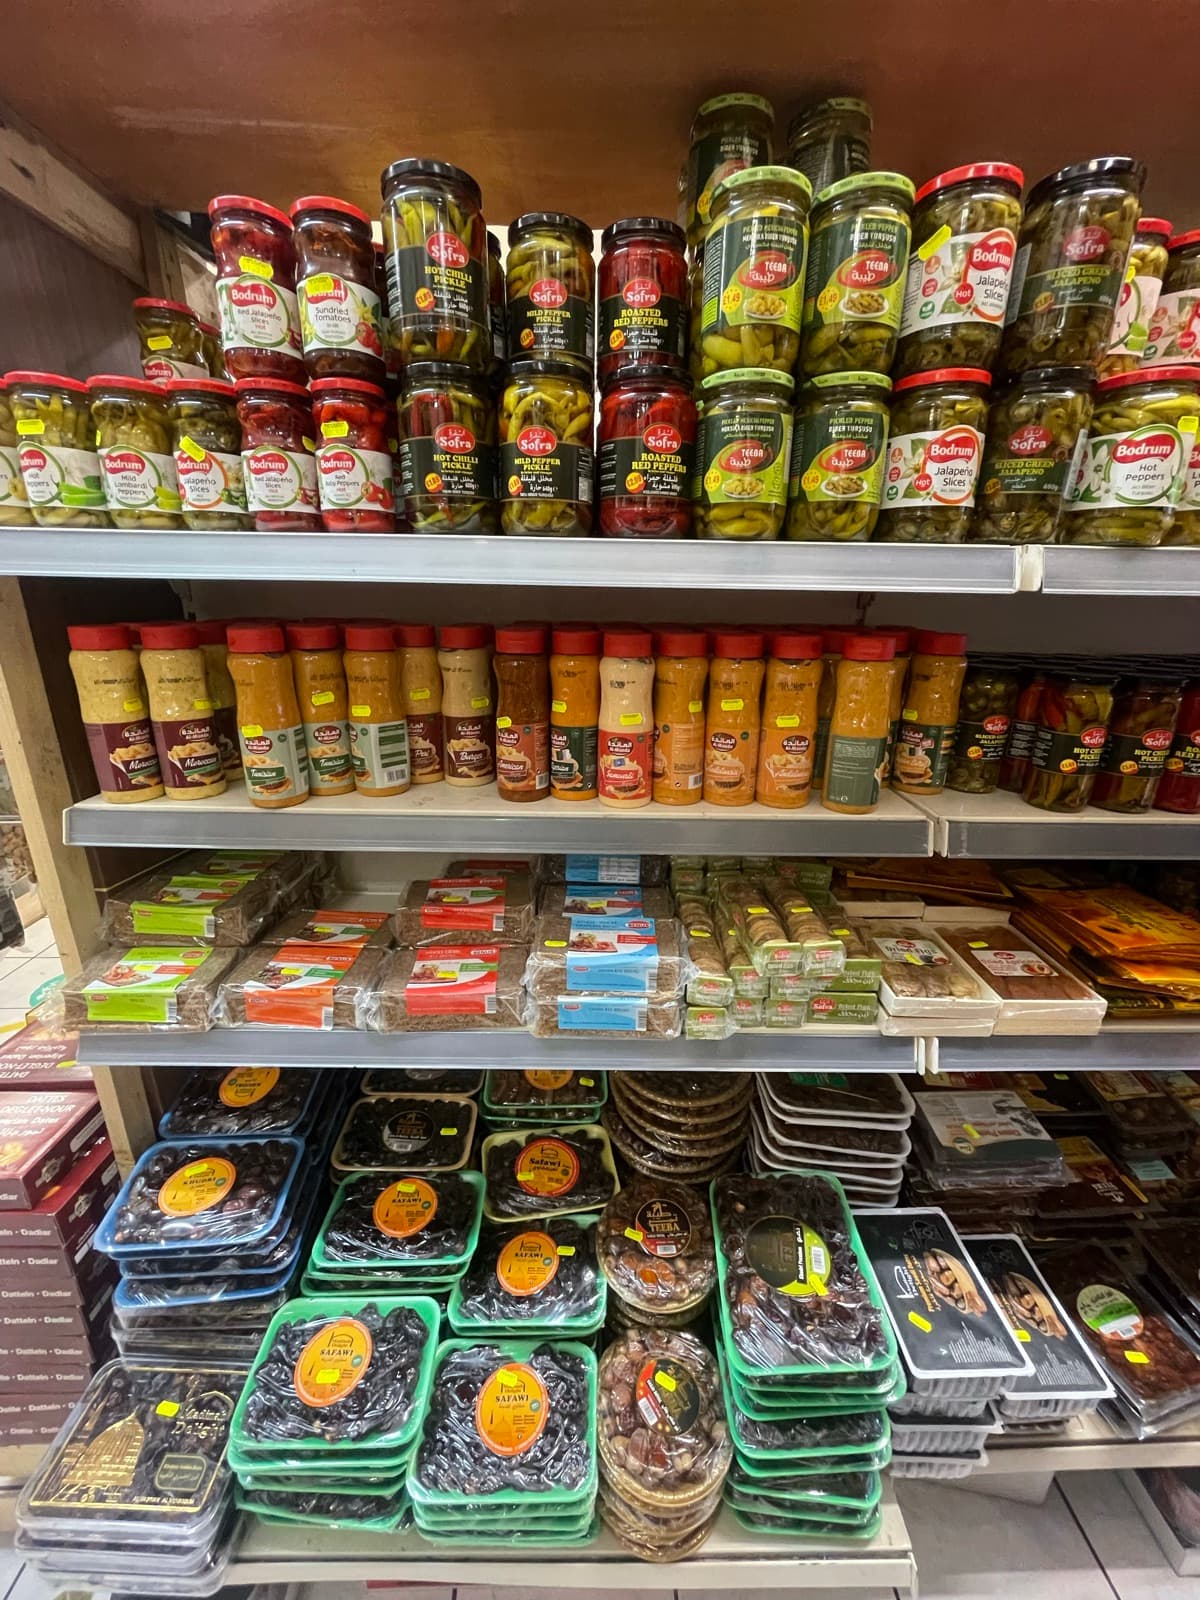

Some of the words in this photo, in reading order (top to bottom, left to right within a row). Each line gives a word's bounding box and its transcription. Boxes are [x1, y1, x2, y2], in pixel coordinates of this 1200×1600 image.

[430, 244, 466, 264] Sofra
[1065, 239, 1105, 257] Sofra
[973, 246, 1011, 266] Bodrum
[424, 266, 442, 276] HOT
[446, 271, 473, 284] CHILLI
[434, 276, 466, 289] PICKLE
[231, 289, 274, 306] Bodrum
[533, 290, 563, 304] Sofra
[626, 290, 657, 304] Sofra
[956, 290, 972, 299] Hot
[984, 289, 1004, 303] Slices
[315, 305, 349, 316] Sundried
[621, 309, 662, 318] ROASTED
[315, 314, 352, 324] Tomatoes
[613, 318, 631, 327] RED
[632, 317, 669, 327] PEPPERS
[439, 436, 472, 450] Sofra
[520, 438, 553, 452] Sofra
[647, 436, 679, 449] Sofra
[1010, 437, 1048, 451] Sofra
[930, 443, 974, 458] Bodrum
[1116, 442, 1171, 460] Bodrum
[320, 457, 353, 469] Bodrum
[433, 453, 451, 463] HOT
[452, 456, 479, 465] CHILLI
[532, 458, 561, 466] PEPPER
[641, 452, 682, 464] ROASTED
[104, 459, 144, 472] Bodrum
[249, 459, 286, 471] Bodrum
[442, 461, 473, 471] PICKLE
[523, 464, 551, 472] PICKLE
[631, 461, 652, 471] RED
[653, 462, 687, 473] PEPPERS
[1138, 465, 1158, 475] Hot
[934, 465, 974, 479] Jalapeño
[1124, 472, 1165, 484] Peppers
[915, 478, 931, 487] Hot
[942, 477, 967, 488] Slices
[189, 484, 210, 494] Slices
[649, 1223, 681, 1233] TEEBA
[319, 1348, 355, 1357] SAFAWI
[495, 1394, 530, 1403] SAFAWI
